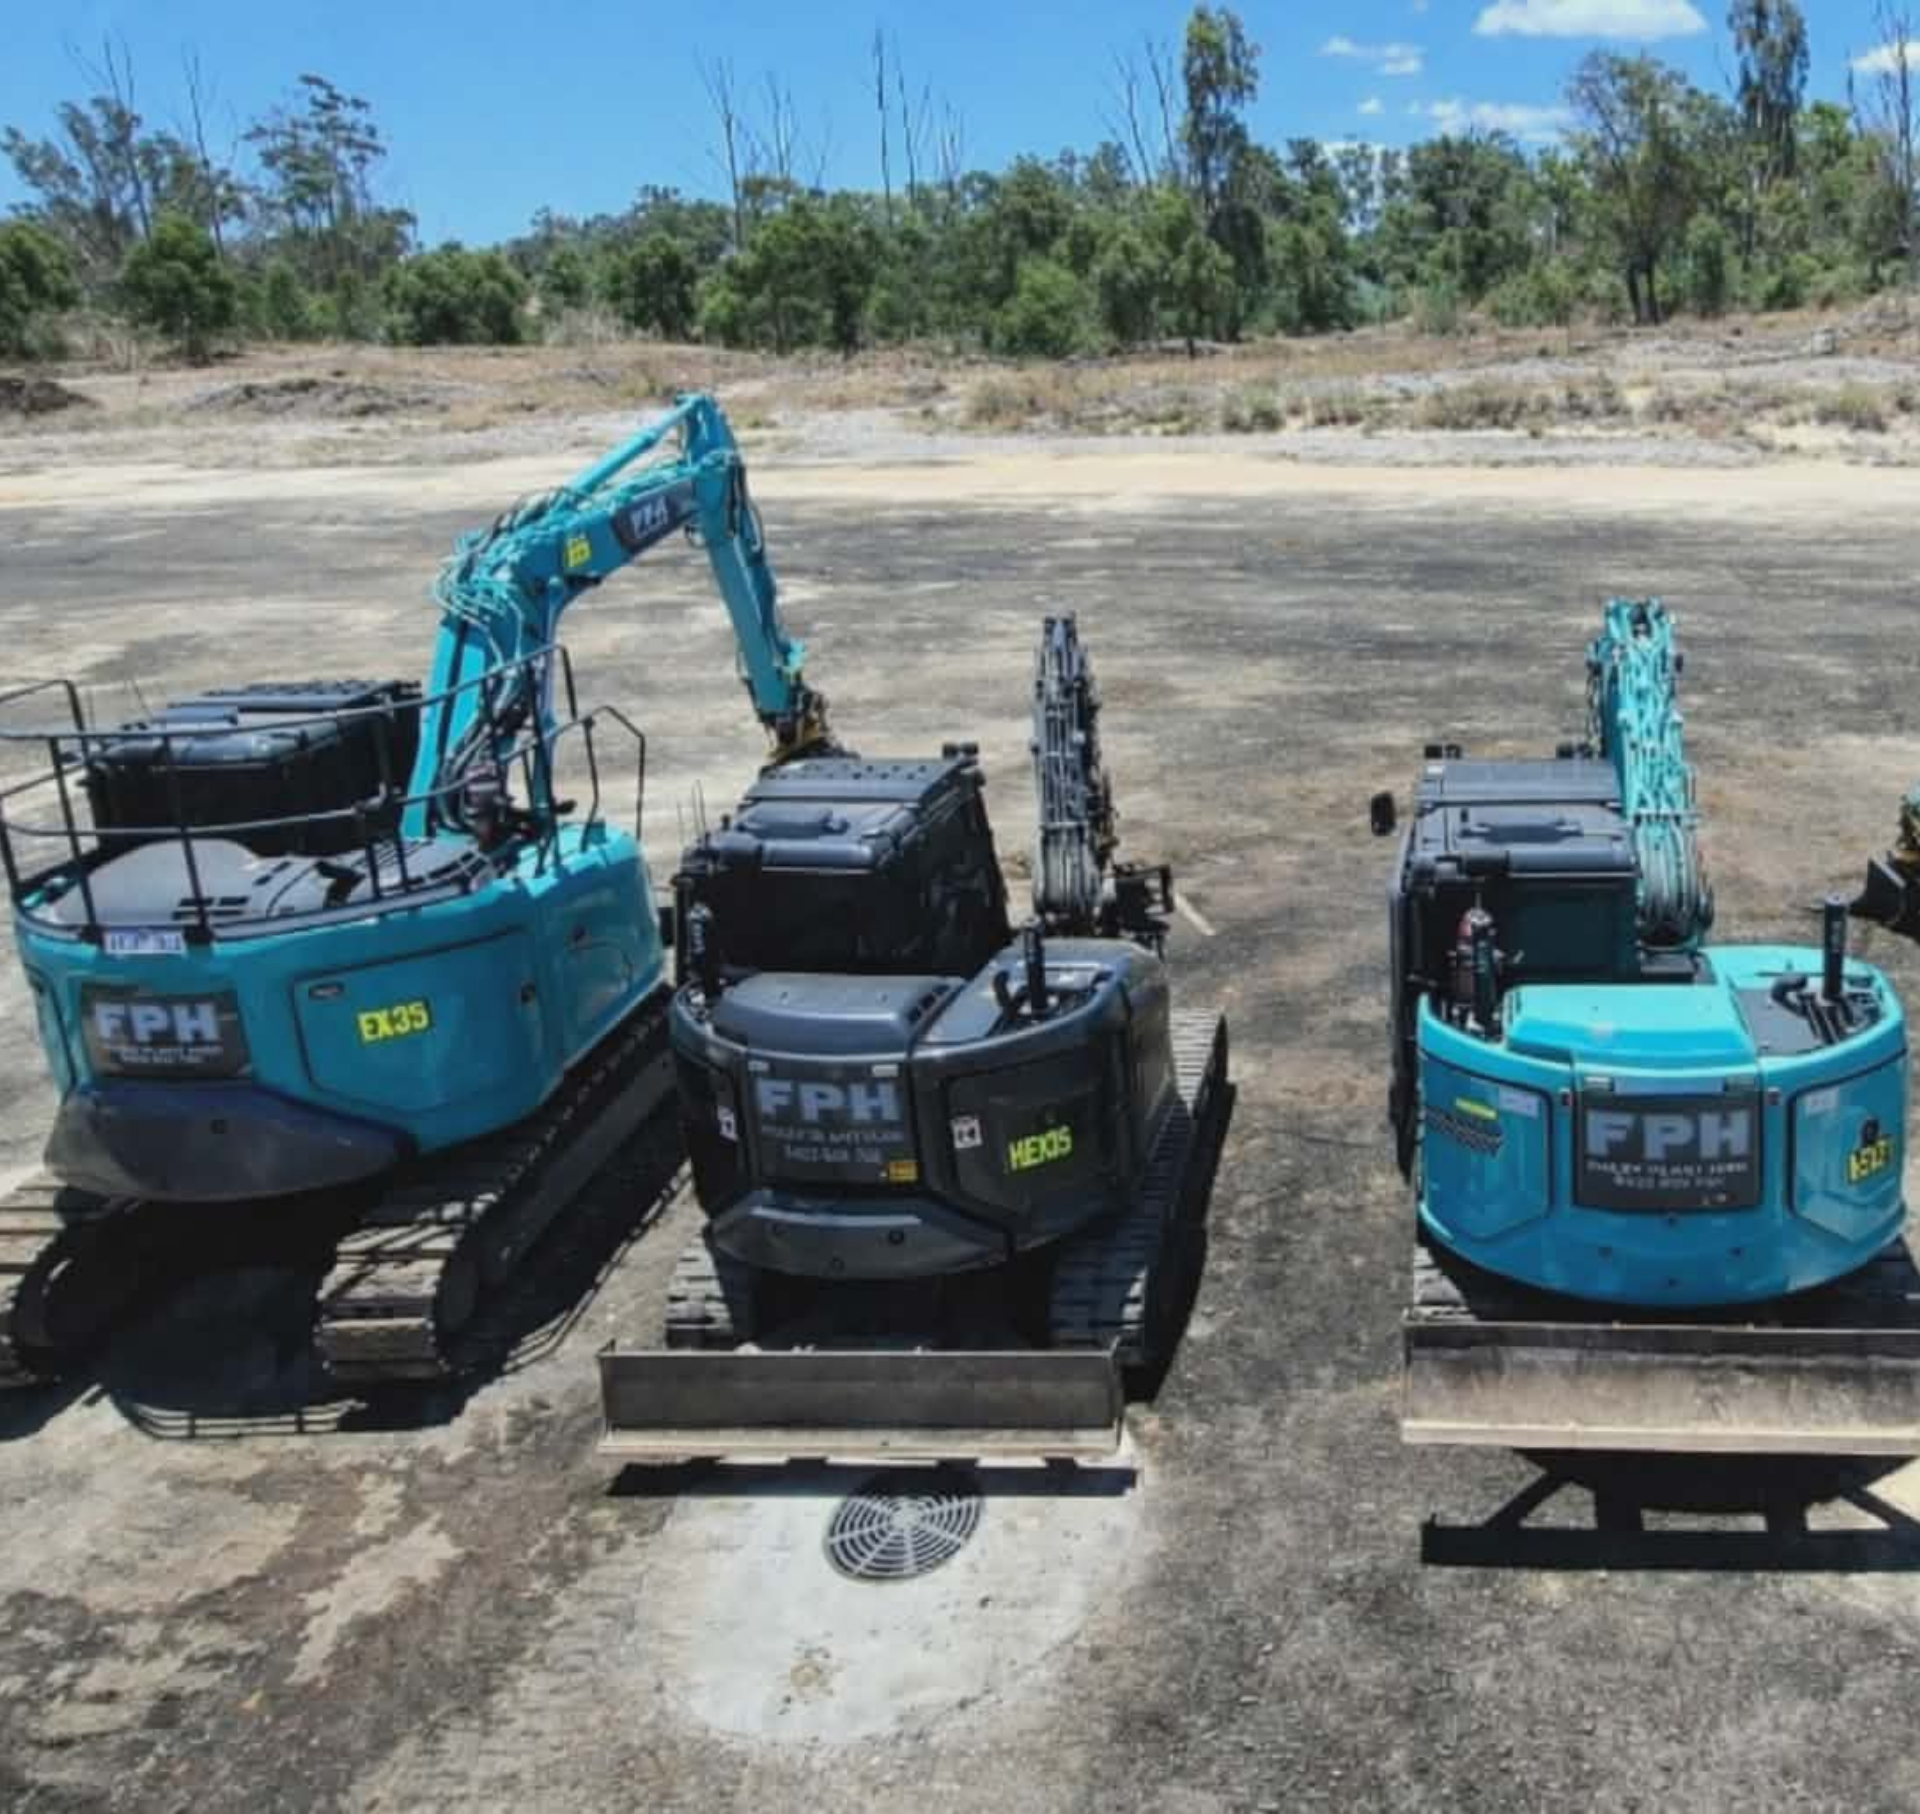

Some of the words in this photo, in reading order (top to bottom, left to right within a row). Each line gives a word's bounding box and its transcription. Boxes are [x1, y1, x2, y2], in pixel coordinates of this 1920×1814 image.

[95, 1002, 218, 1043] FPH
[359, 1001, 429, 1043] EX35
[757, 1078, 900, 1121] FPH
[1587, 1110, 1749, 1160] FPH
